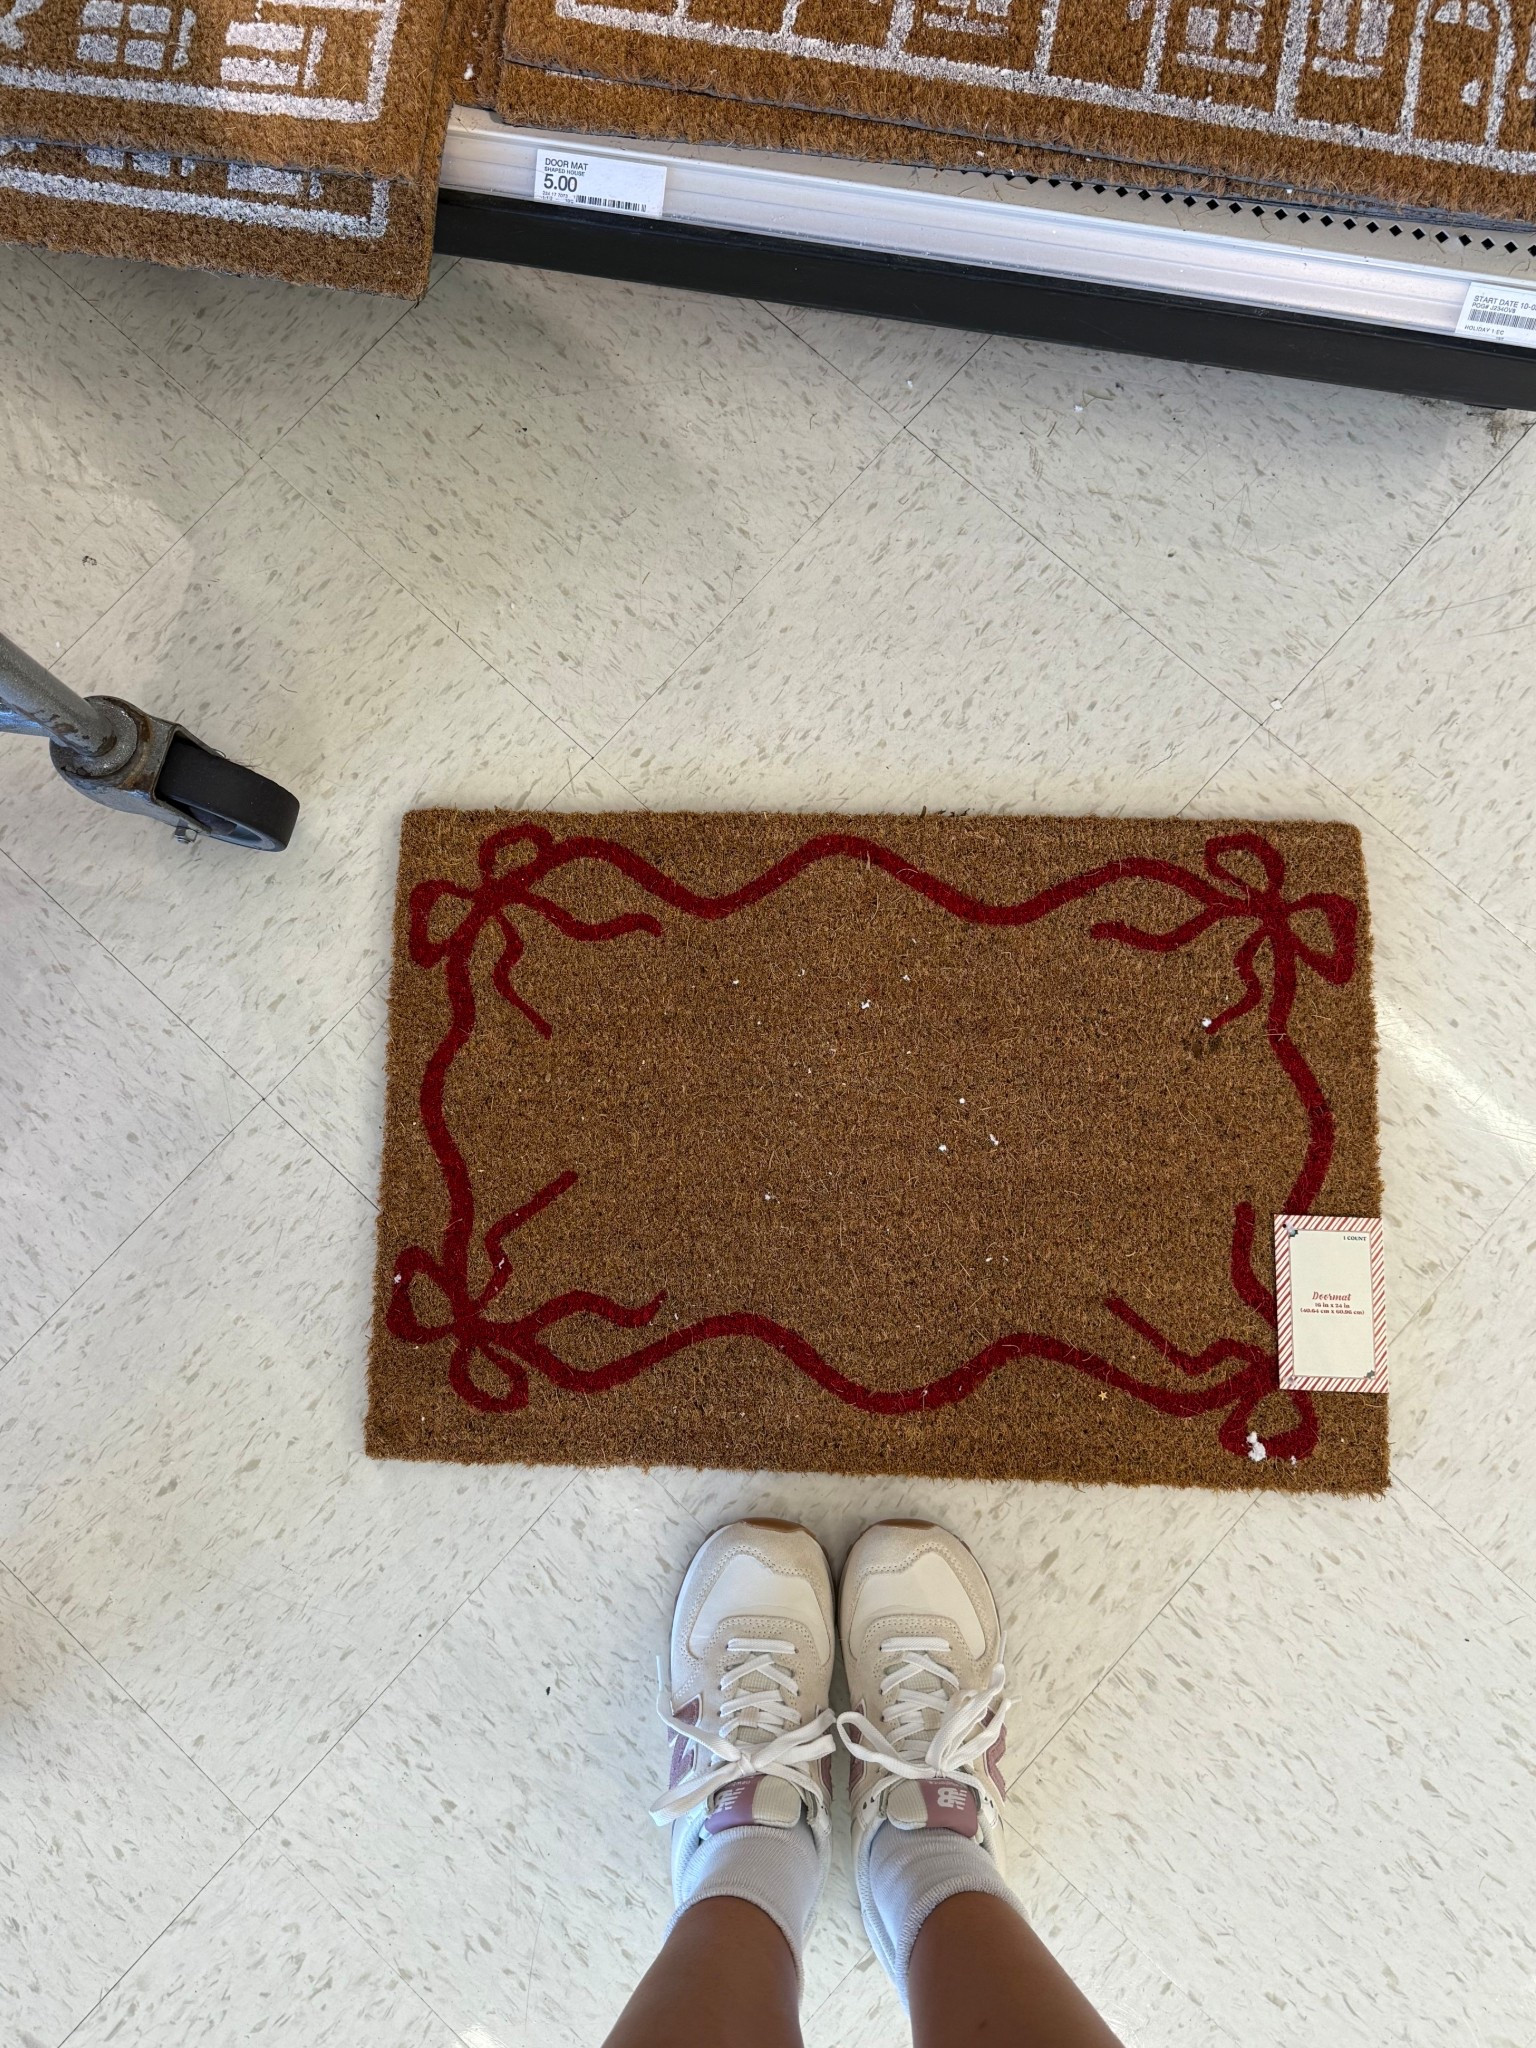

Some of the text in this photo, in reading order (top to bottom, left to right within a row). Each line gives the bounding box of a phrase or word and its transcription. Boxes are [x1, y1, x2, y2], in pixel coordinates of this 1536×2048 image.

[545, 157, 589, 171] DOOR MAT
[544, 166, 586, 177] SHAPED HOUSE
[543, 173, 578, 193] 5.00
[1473, 295, 1498, 305] START
[1498, 298, 1519, 309] DATE
[1464, 325, 1491, 333] HOLIDAY
[1312, 1291, 1352, 1301] Doormat
